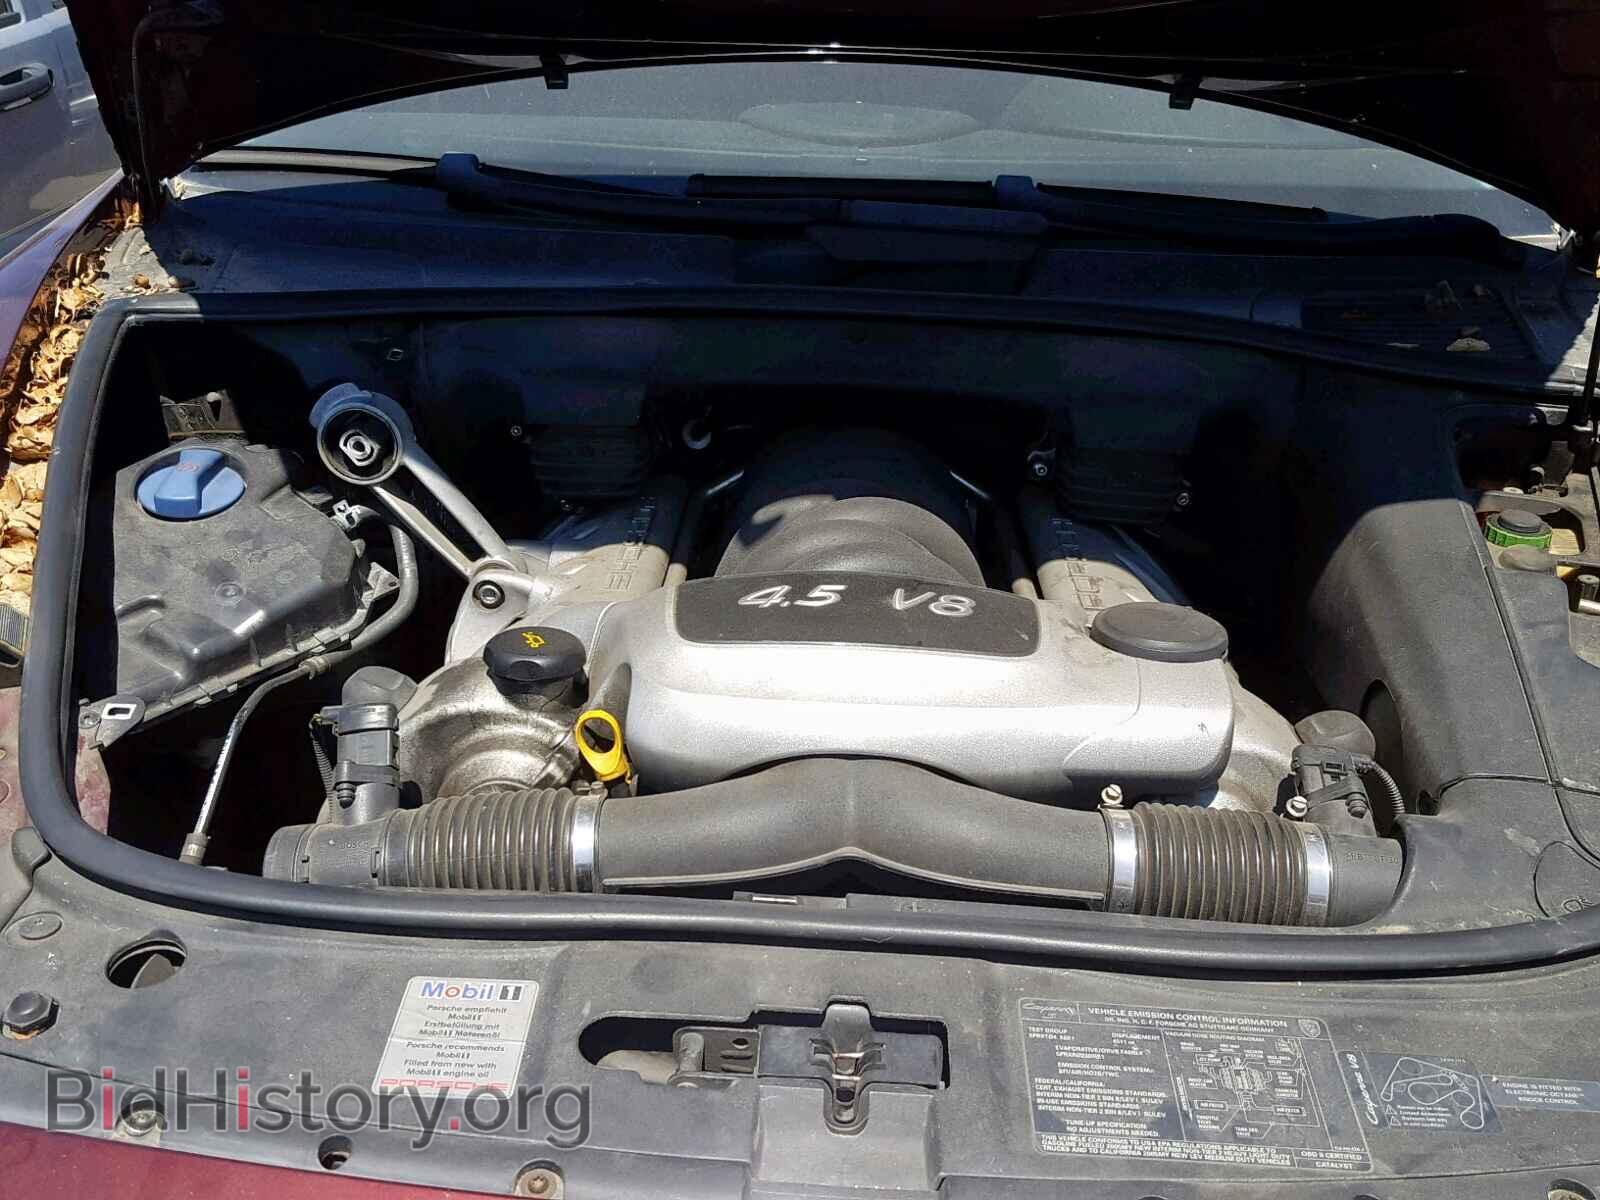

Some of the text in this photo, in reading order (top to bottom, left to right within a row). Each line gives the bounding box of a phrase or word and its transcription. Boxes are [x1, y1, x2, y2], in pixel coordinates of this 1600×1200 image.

[737, 584, 976, 617] 4.5 V8
[421, 981, 494, 1000] Mobil
[1088, 1007, 1288, 1028] VEHICLE EMISSION CONTROL INFORMATION
[406, 1041, 505, 1053] Porsche recommends
[403, 1059, 428, 1067] Filled
[431, 1060, 452, 1068] from
[477, 1061, 497, 1070] with
[443, 1070, 476, 1079] engine
